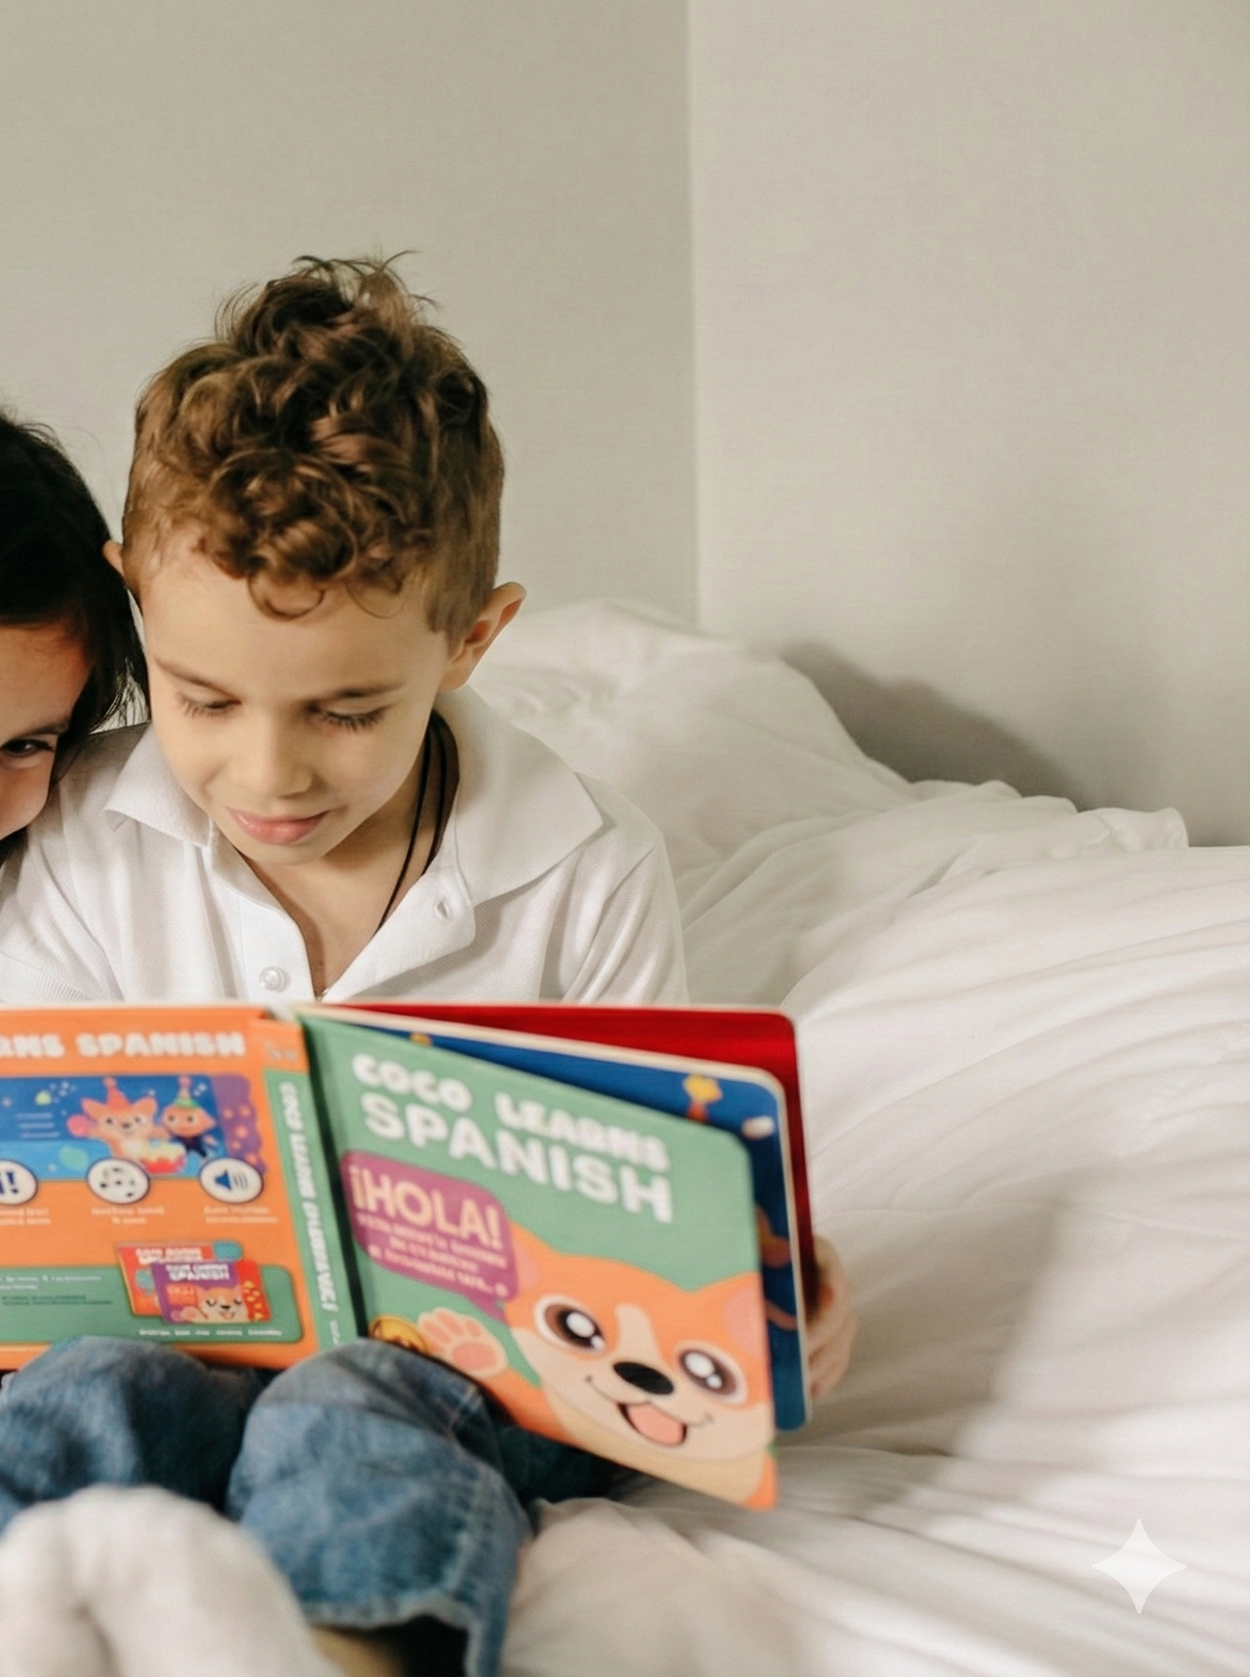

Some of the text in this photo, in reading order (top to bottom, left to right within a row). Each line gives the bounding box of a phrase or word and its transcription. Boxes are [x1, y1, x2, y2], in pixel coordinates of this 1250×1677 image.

[75, 1031, 246, 1058] SPANISH
[352, 1053, 671, 1174] COCO LEARNS
[360, 1092, 673, 1225] SPANISH
[348, 1164, 503, 1250] ¡HOLA!
